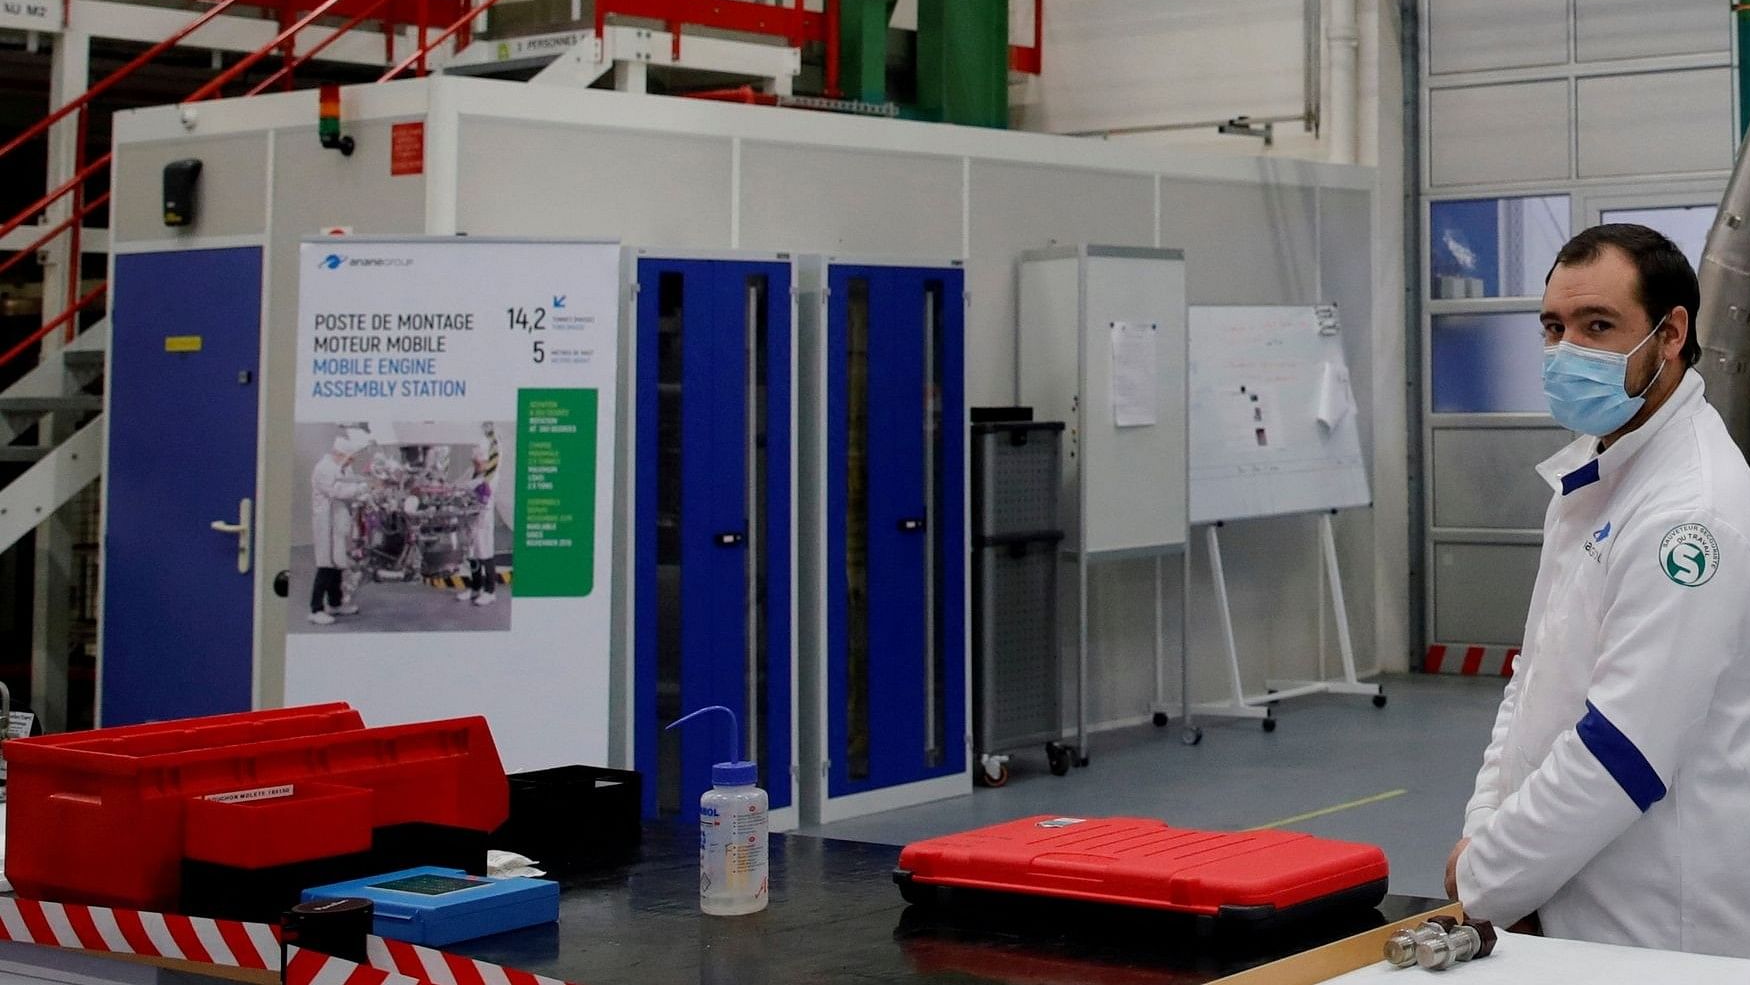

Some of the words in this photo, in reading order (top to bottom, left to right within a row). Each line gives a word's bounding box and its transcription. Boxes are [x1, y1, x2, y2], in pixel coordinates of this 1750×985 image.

[314, 314, 366, 331] POSTE
[371, 314, 392, 331] DE
[398, 314, 474, 331] MONTAGE
[507, 307, 546, 334] 14,2
[313, 335, 381, 353] MOTEUR
[386, 335, 446, 353] MOBILE
[533, 340, 545, 364] 5
[312, 358, 373, 375] MOBILE
[378, 358, 436, 375] ENGINE
[312, 380, 397, 398] ASSEMBLY
[401, 380, 466, 398] STATION
[1663, 525, 1698, 547] SAUVETEUR
[1677, 535, 1687, 545] DU
